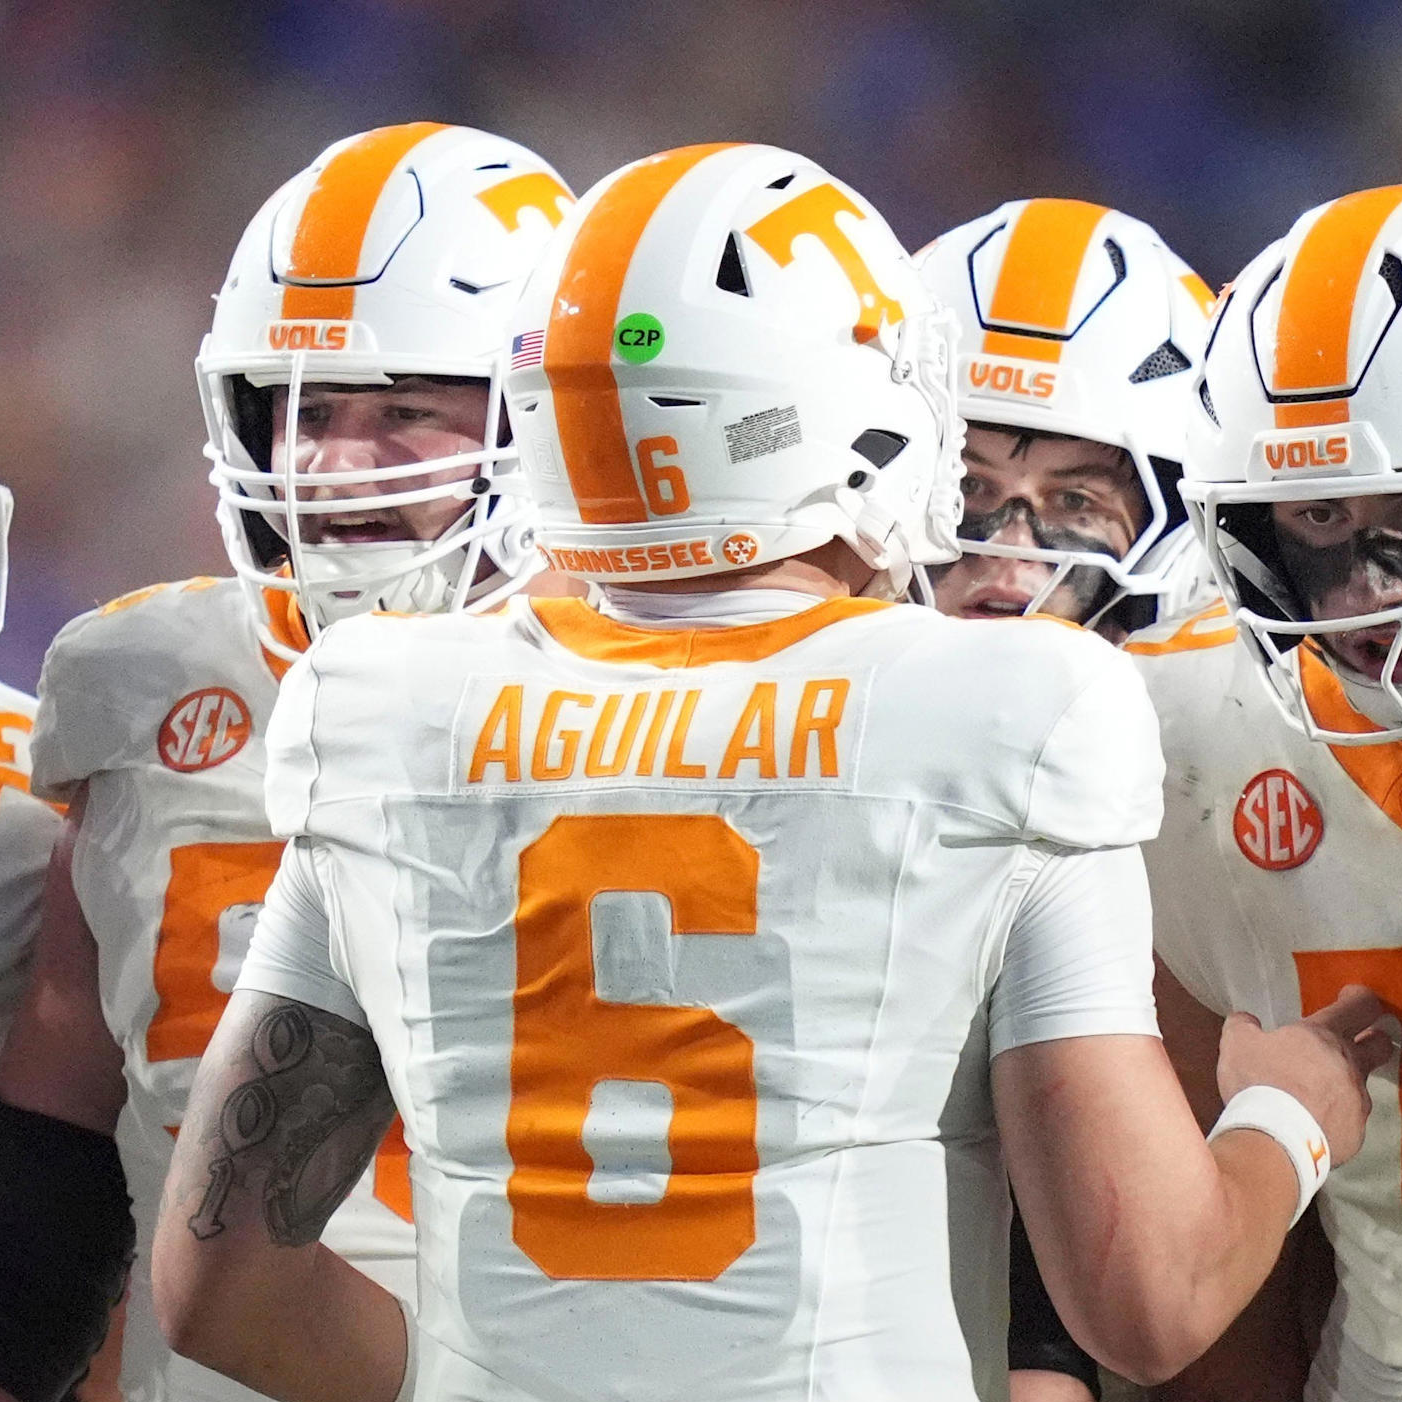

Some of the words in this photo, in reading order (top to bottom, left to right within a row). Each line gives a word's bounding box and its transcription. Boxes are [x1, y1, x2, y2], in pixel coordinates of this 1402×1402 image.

[745, 183, 905, 345] T
[269, 325, 347, 350] VOLS
[619, 328, 661, 347] C2P
[970, 361, 1055, 398] VOLS
[637, 435, 691, 516] 6
[1265, 437, 1349, 470] VOLS
[550, 540, 715, 574] TENNESSEE
[164, 694, 245, 766] SEC
[467, 677, 851, 784] AGUILAR
[1242, 775, 1315, 863] SEC
[505, 814, 762, 1282] 6
